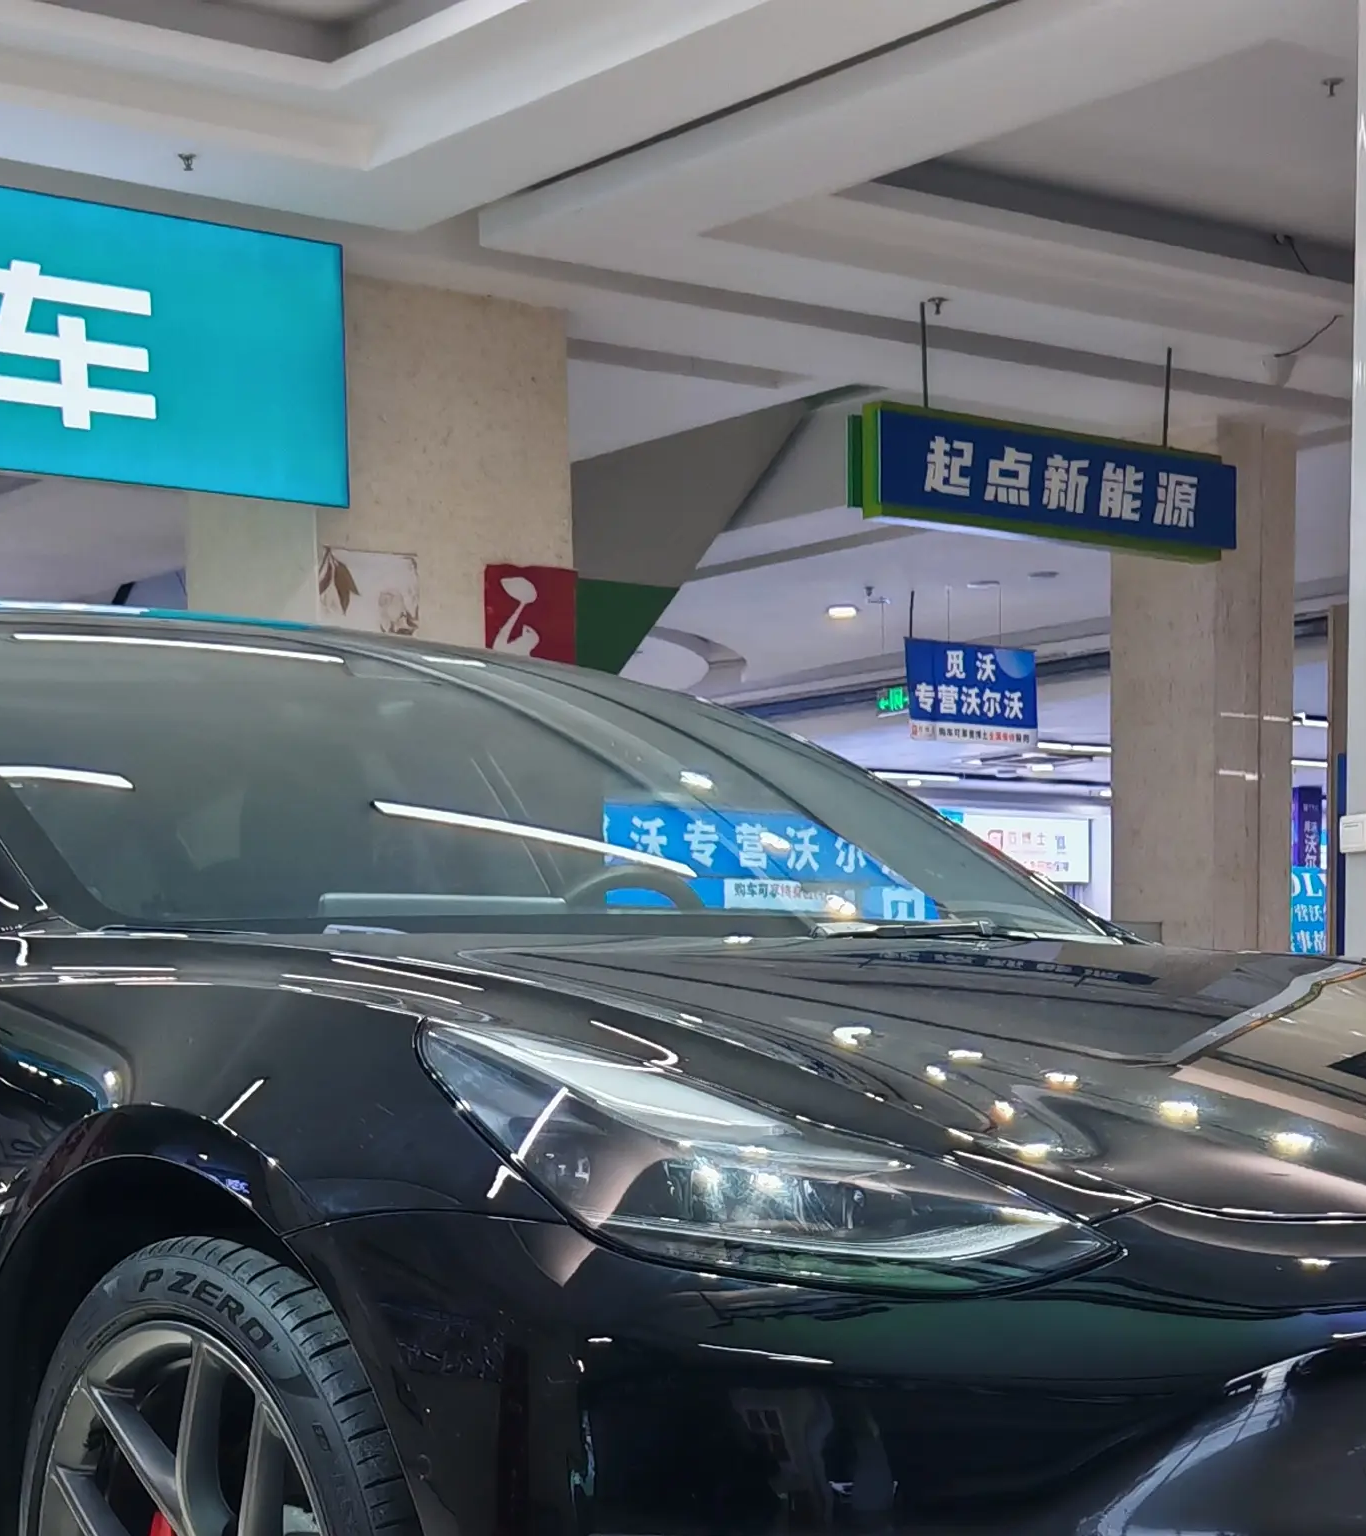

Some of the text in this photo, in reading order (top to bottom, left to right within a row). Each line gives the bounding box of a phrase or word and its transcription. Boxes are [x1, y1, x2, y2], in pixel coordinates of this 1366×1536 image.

[923, 436, 1199, 528] 起点新能源
[915, 682, 1023, 720] 专营沃尔沃
[139, 1269, 274, 1350] P ZERO
